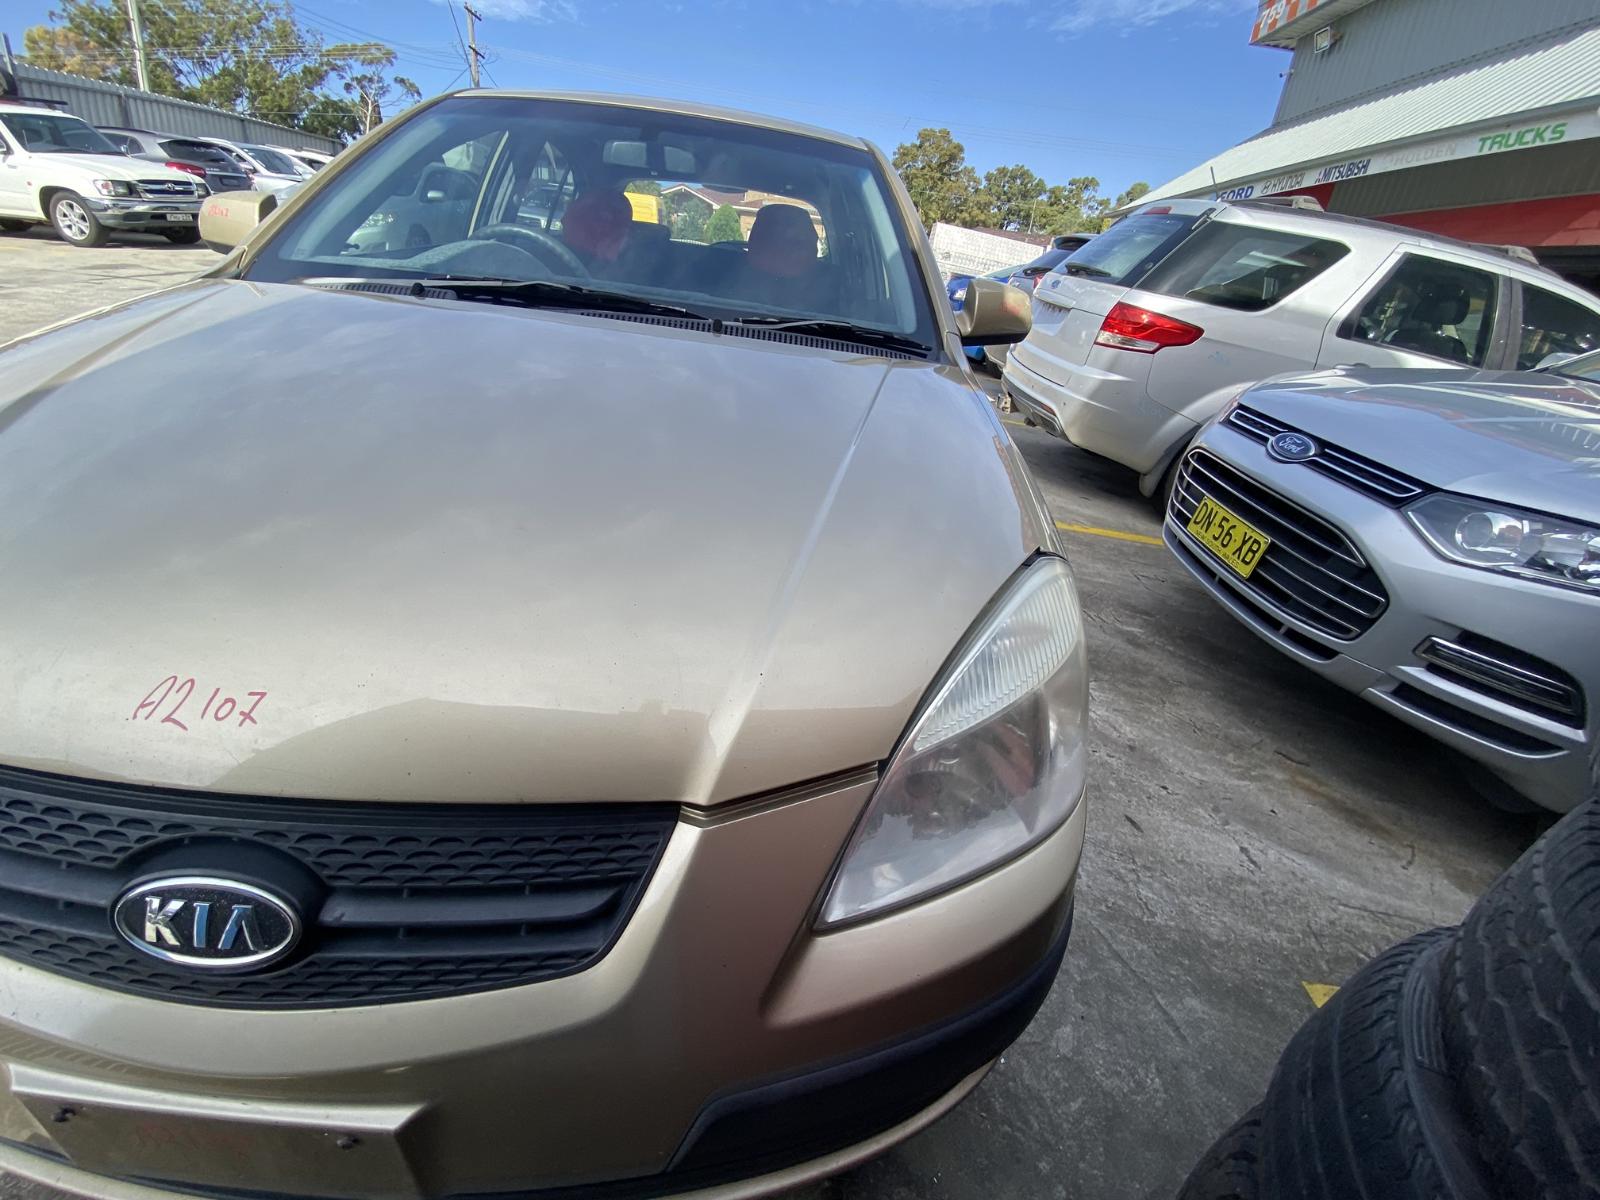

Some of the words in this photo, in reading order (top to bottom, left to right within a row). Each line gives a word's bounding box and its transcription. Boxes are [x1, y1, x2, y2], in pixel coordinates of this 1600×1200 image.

[1322, 159, 1371, 181] MITSUBISHI
[1478, 122, 1568, 153] TRUCKS
[1193, 502, 1218, 533] DN
[1212, 515, 1237, 548] 56
[1232, 531, 1262, 566] XB
[144, 896, 267, 953] KIA
